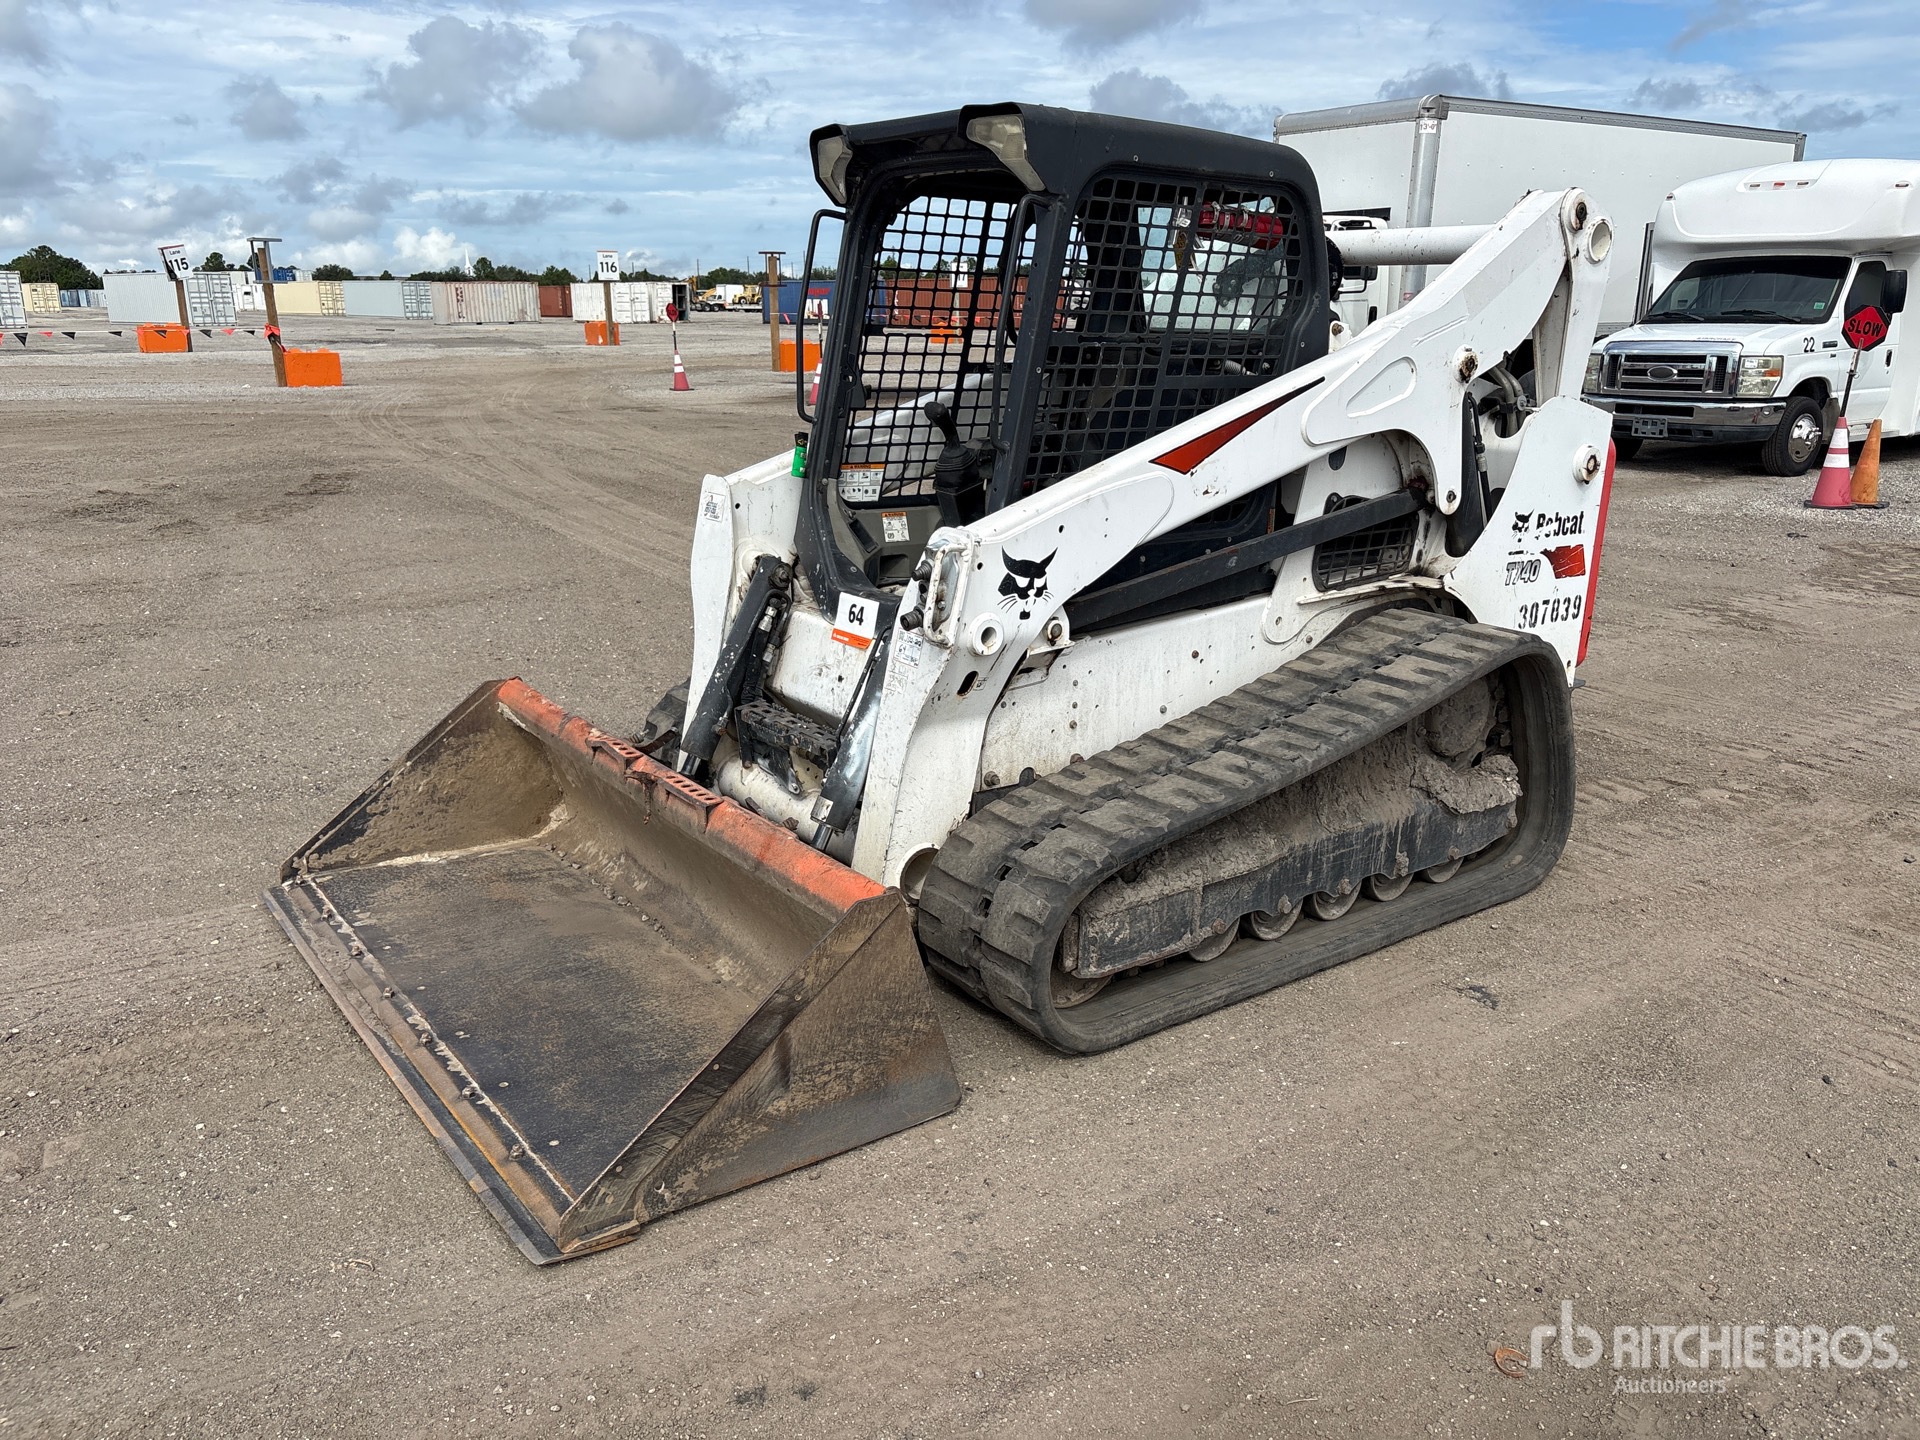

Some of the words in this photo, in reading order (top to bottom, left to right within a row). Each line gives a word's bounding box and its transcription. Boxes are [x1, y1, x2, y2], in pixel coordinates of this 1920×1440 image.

[169, 257, 189, 271] 115
[600, 261, 617, 273] 116
[1848, 318, 1883, 337] SLOW
[1803, 337, 1815, 352] 22
[848, 603, 865, 626] 64
[1518, 595, 1582, 629] 307839
